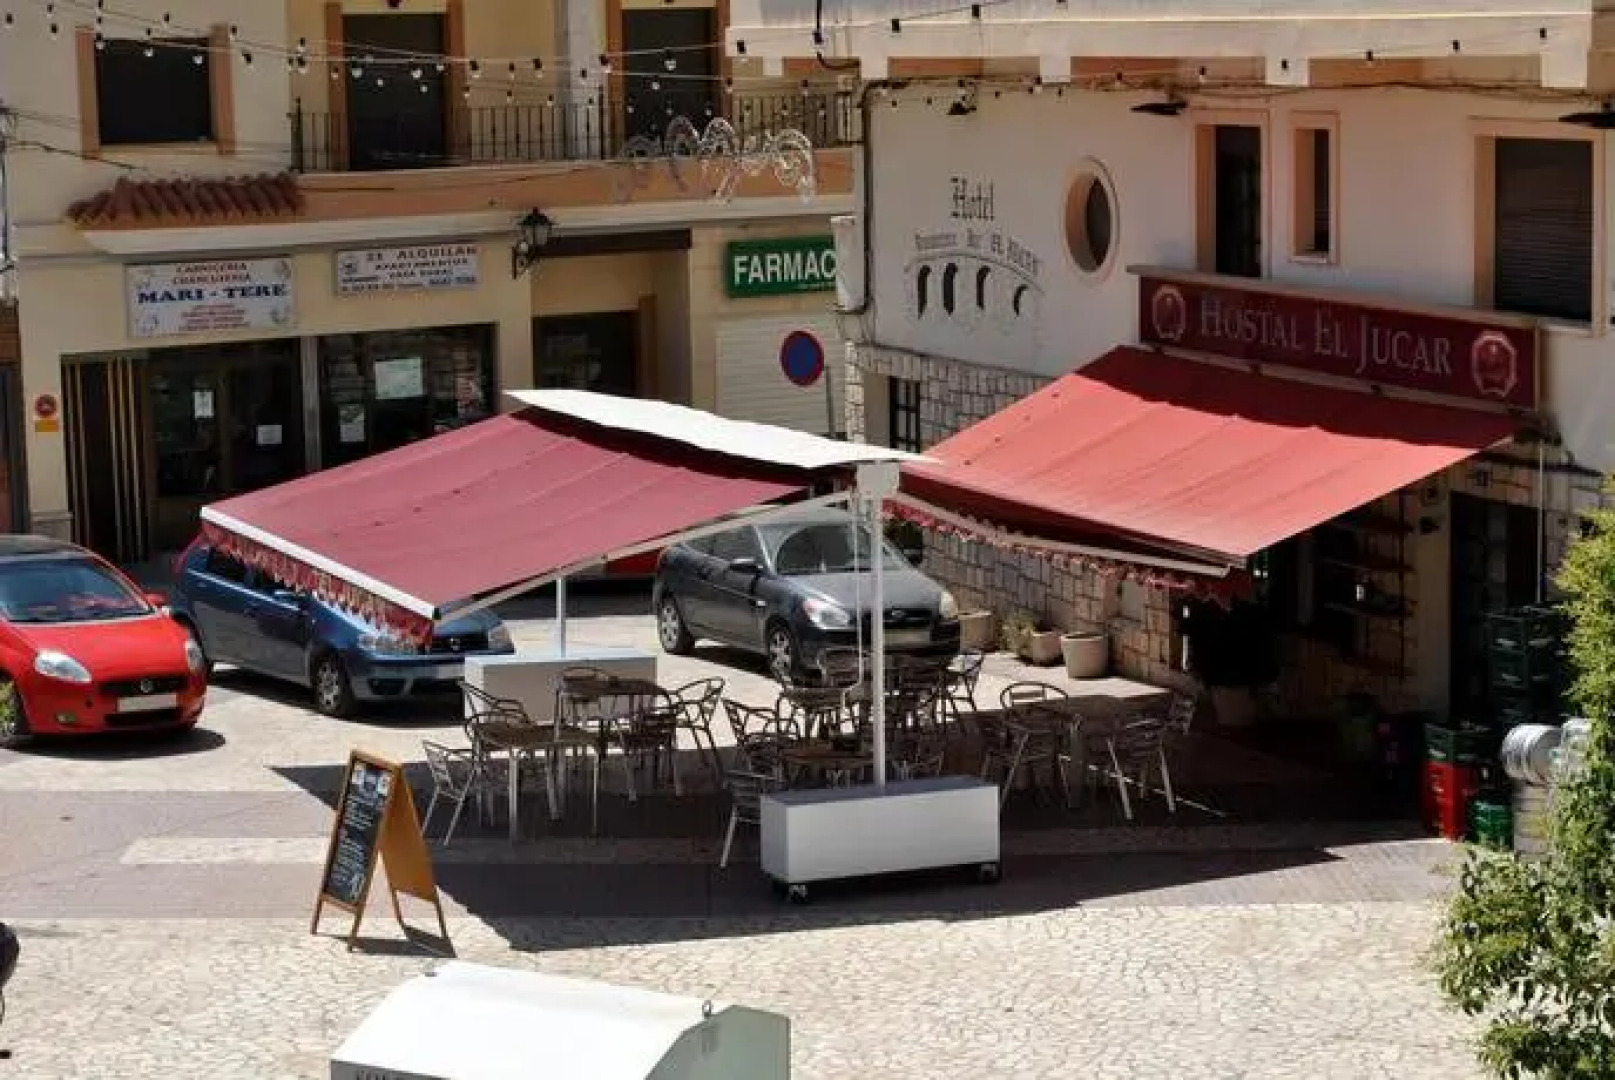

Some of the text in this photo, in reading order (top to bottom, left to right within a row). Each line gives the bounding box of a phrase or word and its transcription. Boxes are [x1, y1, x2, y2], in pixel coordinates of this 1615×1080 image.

[950, 176, 995, 222] Hotel
[138, 289, 204, 304] MARI
[223, 284, 288, 299] TERE
[1200, 297, 1303, 350] HOSTAL
[1354, 314, 1452, 377] JUCAR
